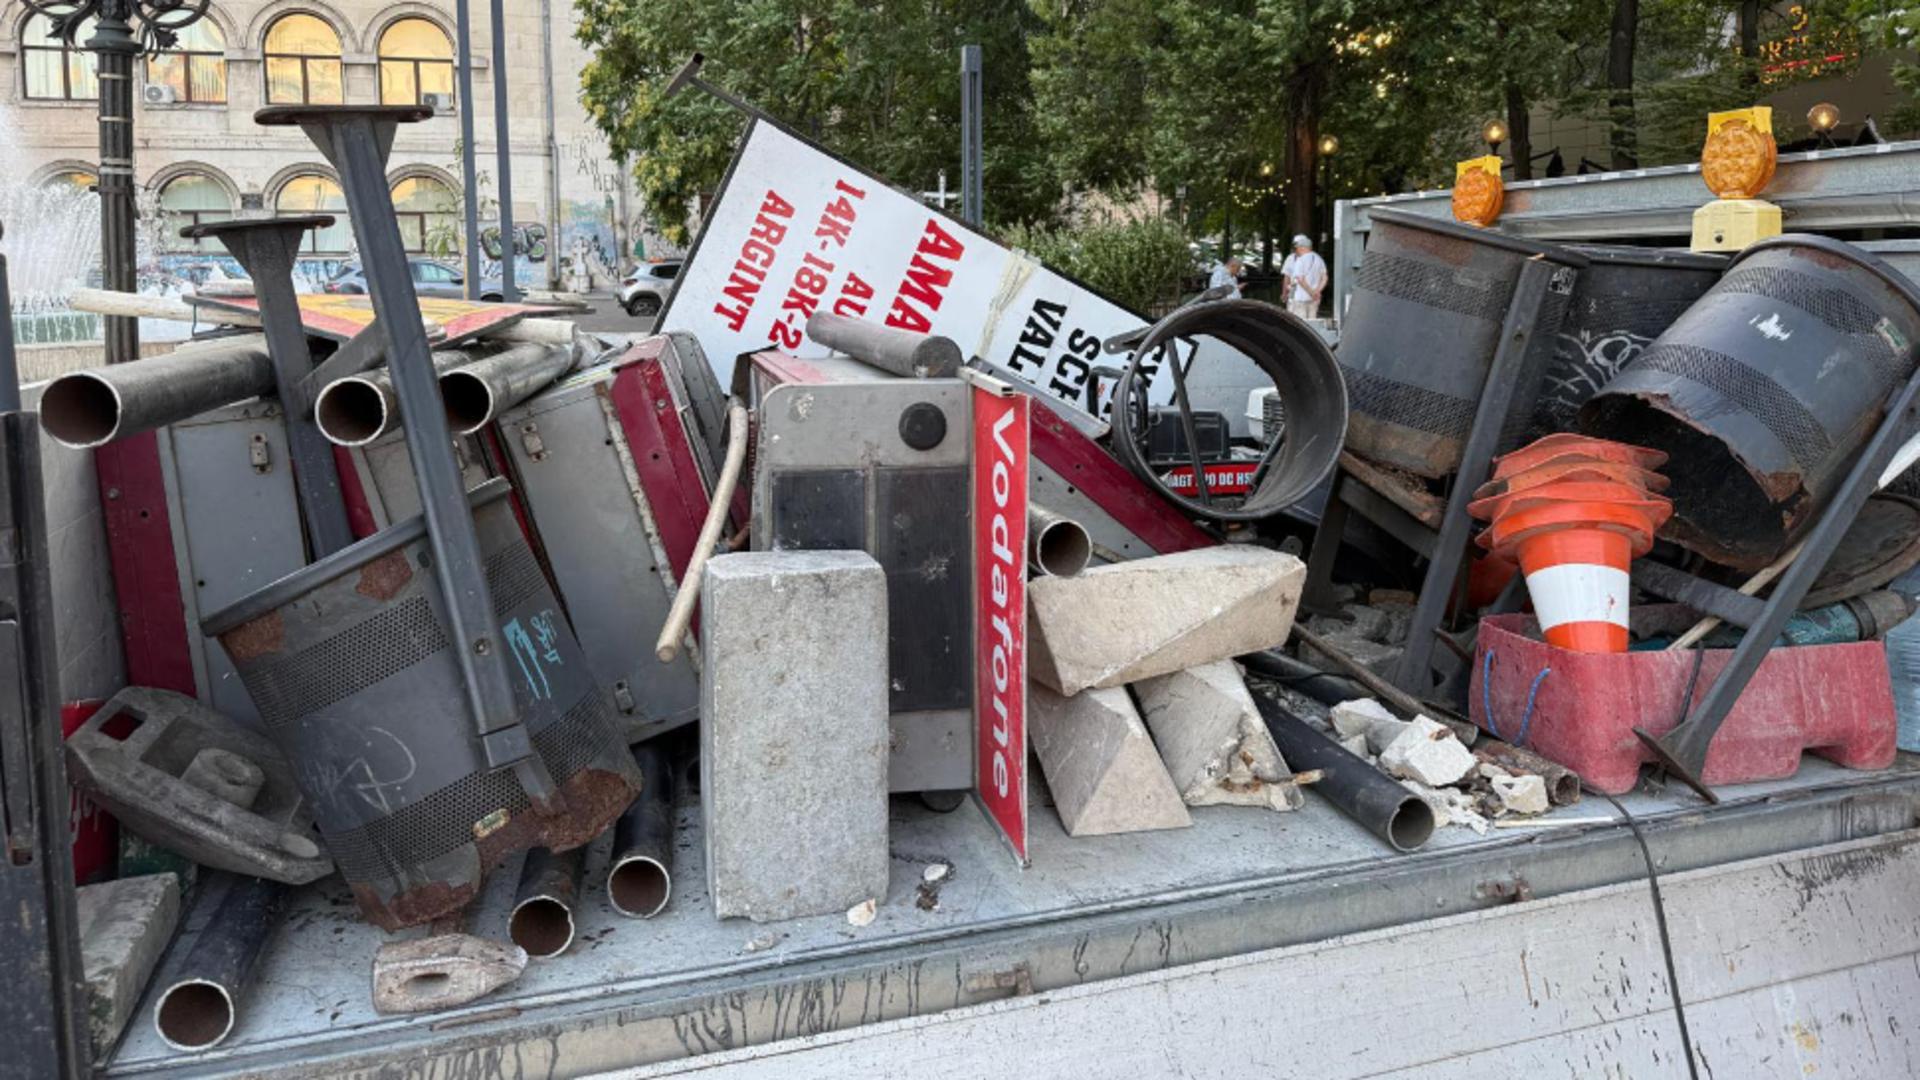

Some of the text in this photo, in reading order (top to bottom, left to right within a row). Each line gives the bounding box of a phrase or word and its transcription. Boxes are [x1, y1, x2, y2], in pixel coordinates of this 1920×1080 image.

[714, 190, 795, 333] ARGINT
[833, 272, 874, 319] AU
[885, 218, 965, 334] AMA
[1007, 298, 1068, 373] VAL
[992, 407, 1015, 799] Vodafone
